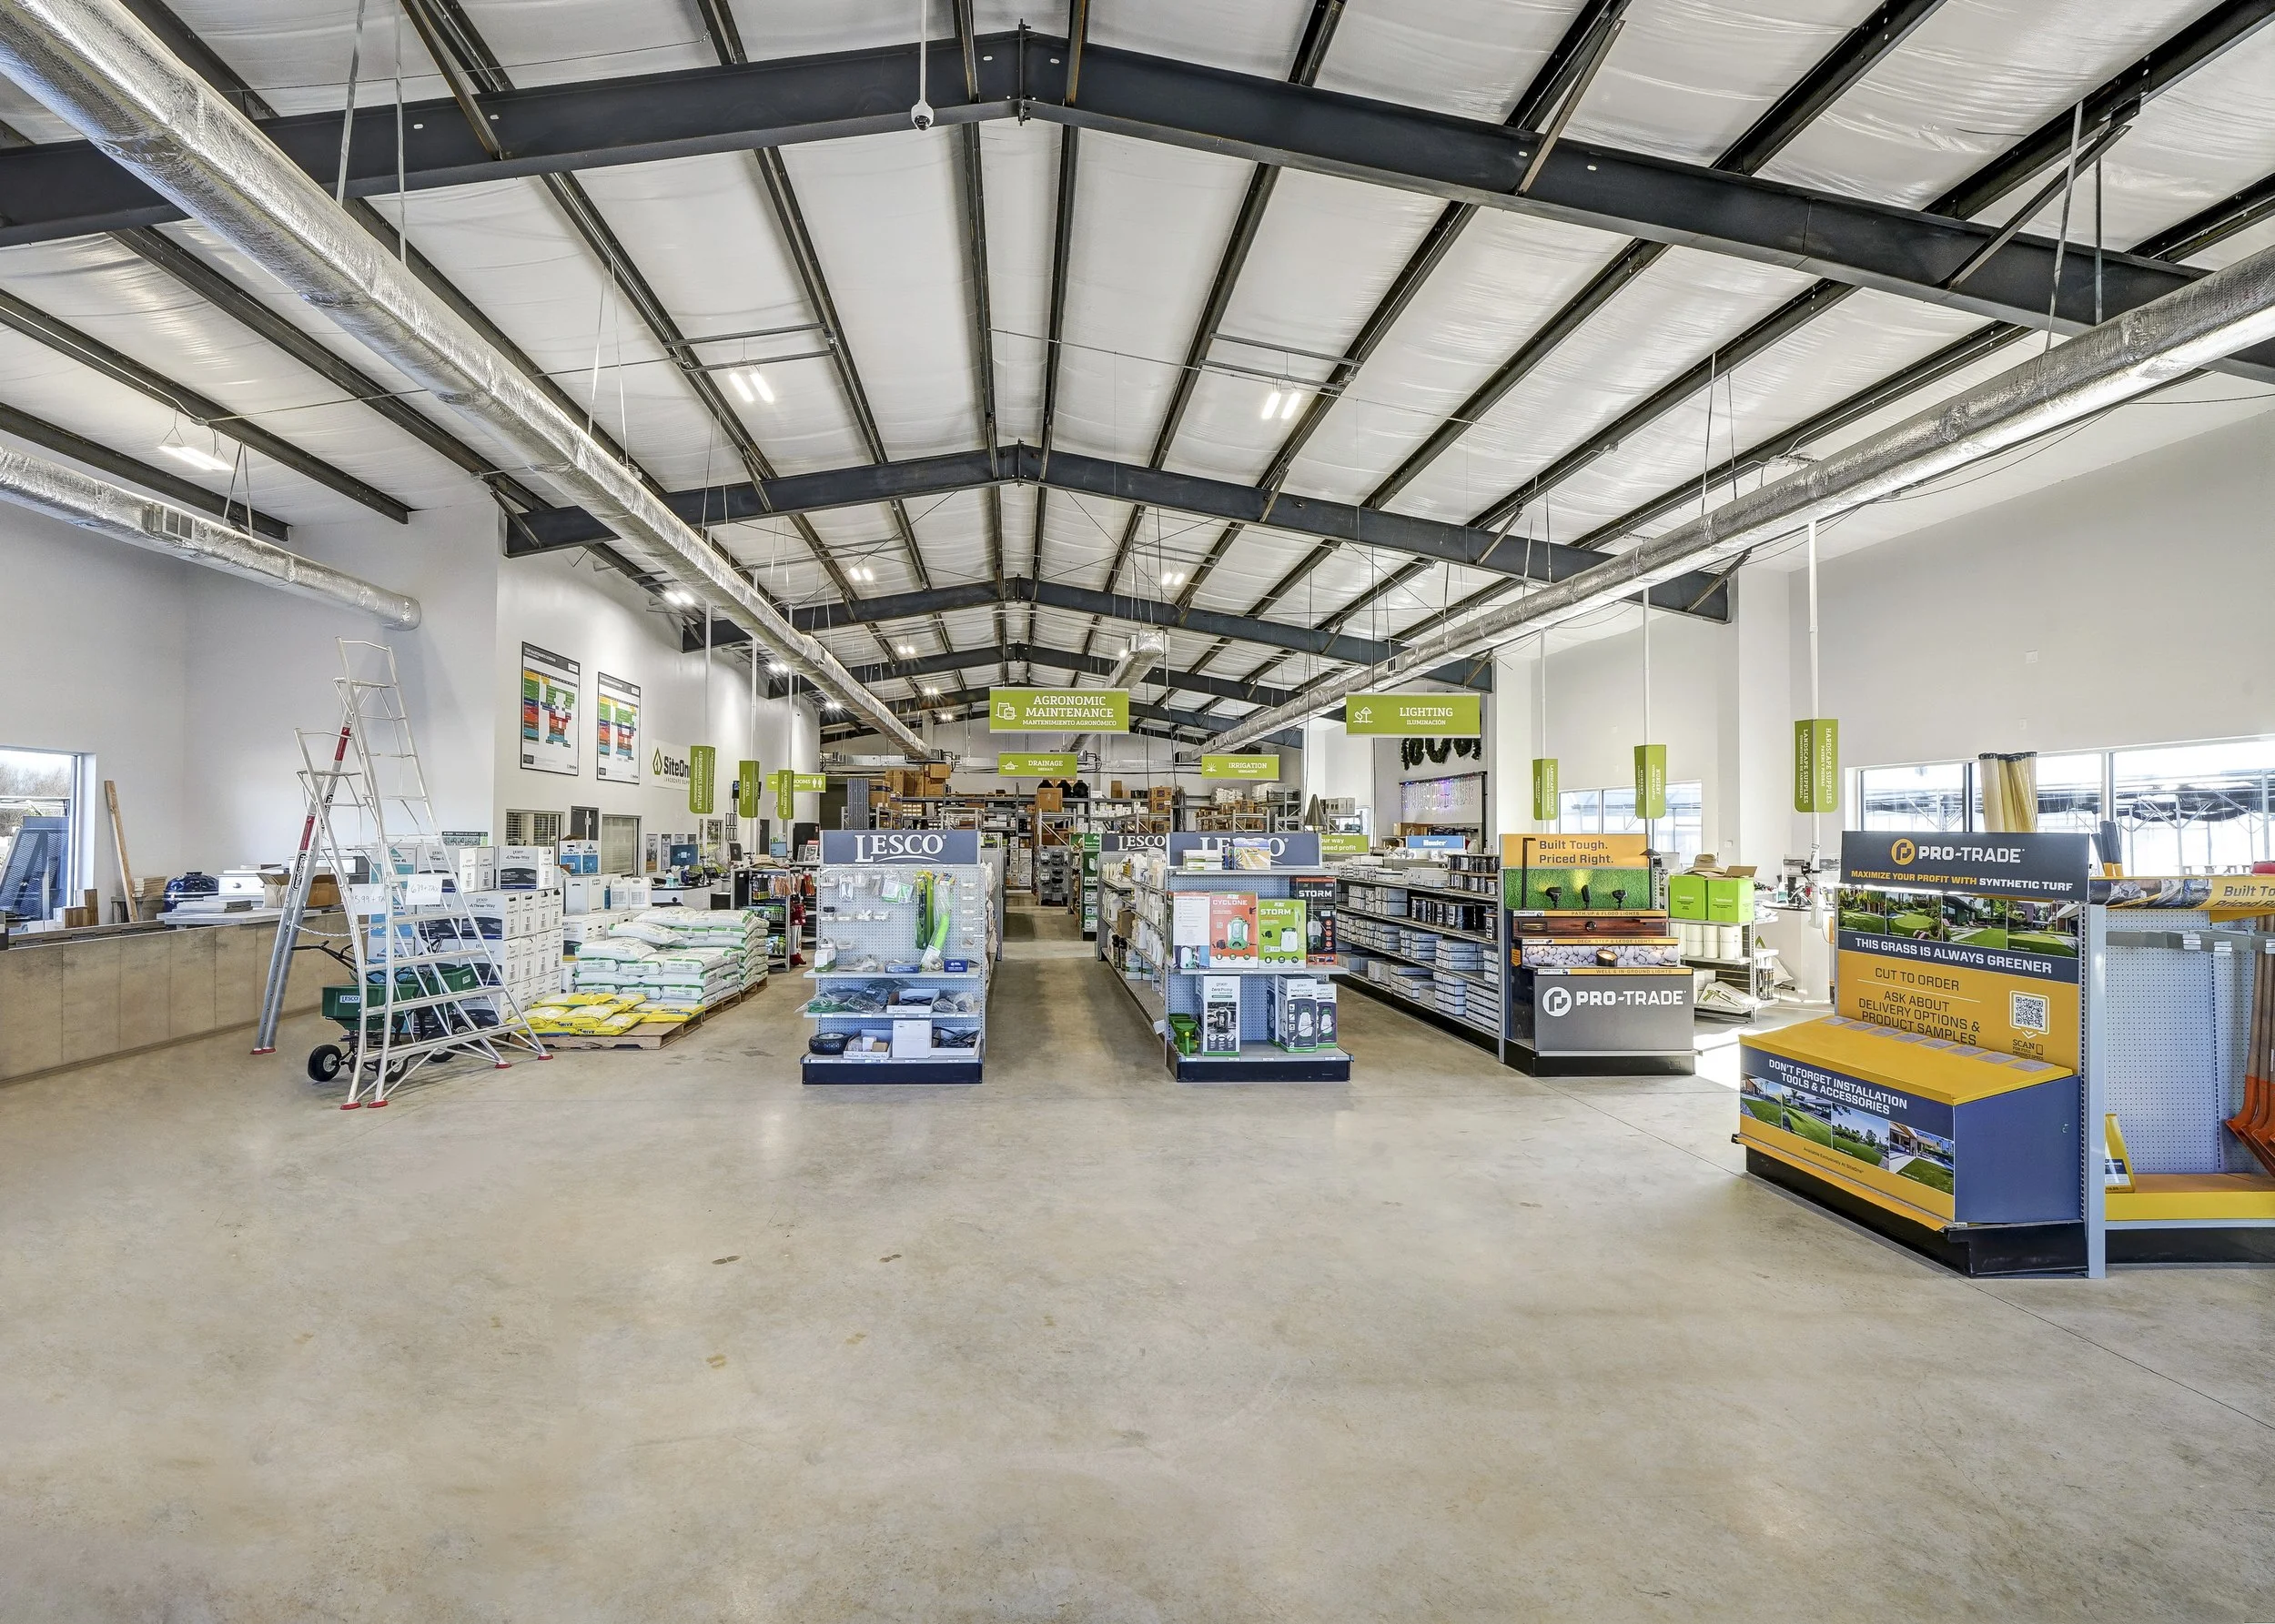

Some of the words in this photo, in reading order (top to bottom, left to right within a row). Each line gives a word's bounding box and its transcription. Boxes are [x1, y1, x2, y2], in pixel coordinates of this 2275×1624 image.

[1033, 695, 1107, 706] AGRONOMIC
[1025, 707, 1114, 718] MAINTENANCE
[1399, 707, 1453, 717] LIGHTING
[664, 756, 692, 779] SiteOn
[854, 834, 943, 862] LESCO
[1117, 835, 1165, 851] LESCO
[1199, 837, 1285, 857] LEO
[1539, 840, 1566, 849] Built
[1570, 840, 1608, 851] Tough.
[1539, 854, 1576, 863] Priced
[1579, 854, 1613, 865] Right.
[1918, 846, 2021, 863] PRO-TRADE
[1851, 870, 1891, 880] MAXIMIZE
[1892, 873, 1915, 882] YOUR
[1917, 874, 1949, 884] PROFIT
[1951, 876, 1977, 885] WITH
[1979, 878, 2039, 889] SYNTHETIC
[2042, 881, 2073, 891] TURF
[1299, 890, 1332, 898] STORM
[2224, 885, 2256, 897] Built
[1855, 937, 1879, 950] THIS
[1881, 940, 1917, 955] GRASS
[1920, 946, 1931, 956] IS
[1933, 947, 1984, 964] ALWAYS
[1987, 955, 2052, 974] GREENER
[1875, 968, 1896, 980] CUT
[1900, 972, 1915, 983] TO
[1918, 975, 1959, 991] ORDER
[1576, 990, 1684, 1006] PRO-TRADE
[1884, 991, 1906, 1004] ASK
[1909, 995, 1950, 1012] ABOUT
[1859, 998, 1911, 1018] DELIVERY
[1914, 1009, 1967, 1029] OPTIONS
[1971, 1021, 1981, 1033] &
[1862, 1011, 1914, 1032] PRODUCT
[1917, 1023, 1977, 1045] SAMPLES
[2012, 1039, 2035, 1049] SCAN
[1769, 1059, 1794, 1074] DON'T
[1796, 1067, 1831, 1086] FORGET
[1834, 1078, 1907, 1110] INSTALLATION
[1781, 1072, 1809, 1089] TOOLS
[1811, 1082, 1818, 1091] &
[1820, 1084, 1890, 1115] ACCESSORIES
